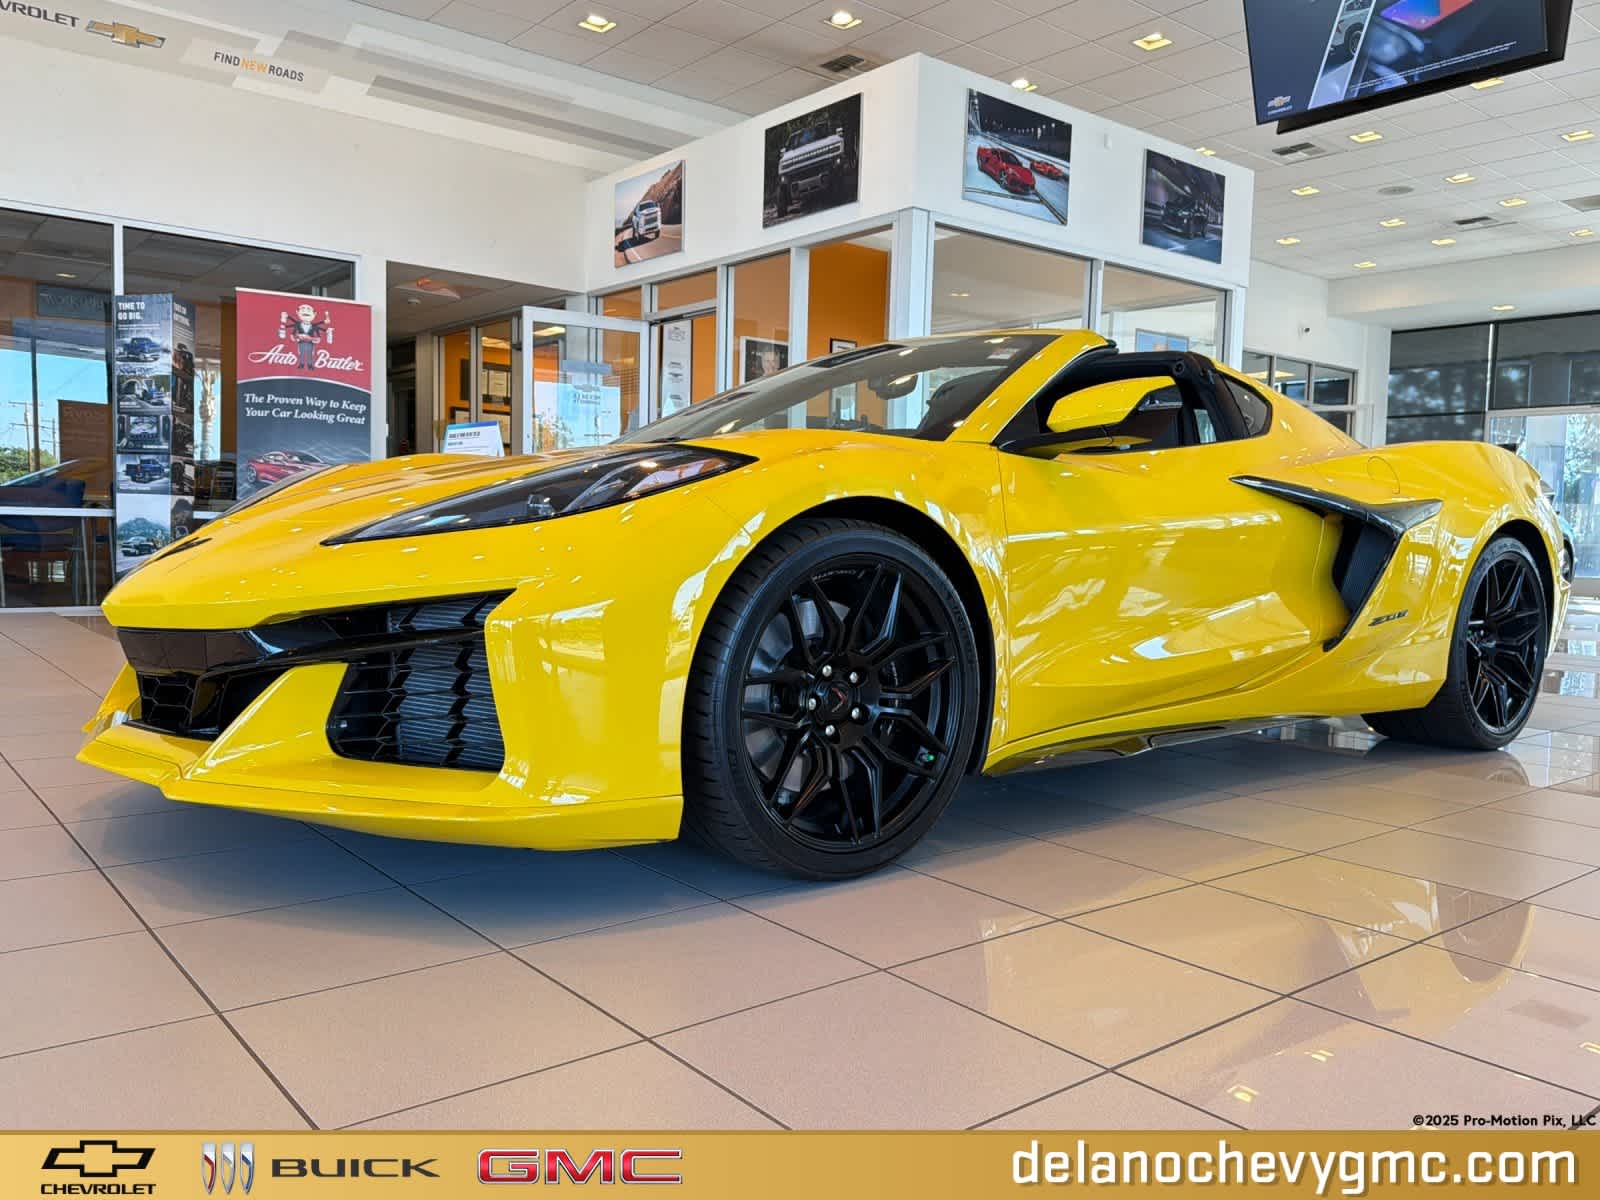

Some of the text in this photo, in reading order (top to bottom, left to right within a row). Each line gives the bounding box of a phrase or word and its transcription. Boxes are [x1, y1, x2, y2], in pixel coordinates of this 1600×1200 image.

[213, 51, 305, 82] FIND NEW ROADS
[118, 302, 136, 310] TIME
[136, 302, 145, 310] TO
[118, 312, 127, 320] GO
[248, 344, 366, 372] Auto Butler
[244, 393, 367, 414] The Proven Way to Keep
[245, 407, 366, 425] Your Car Looking Great
